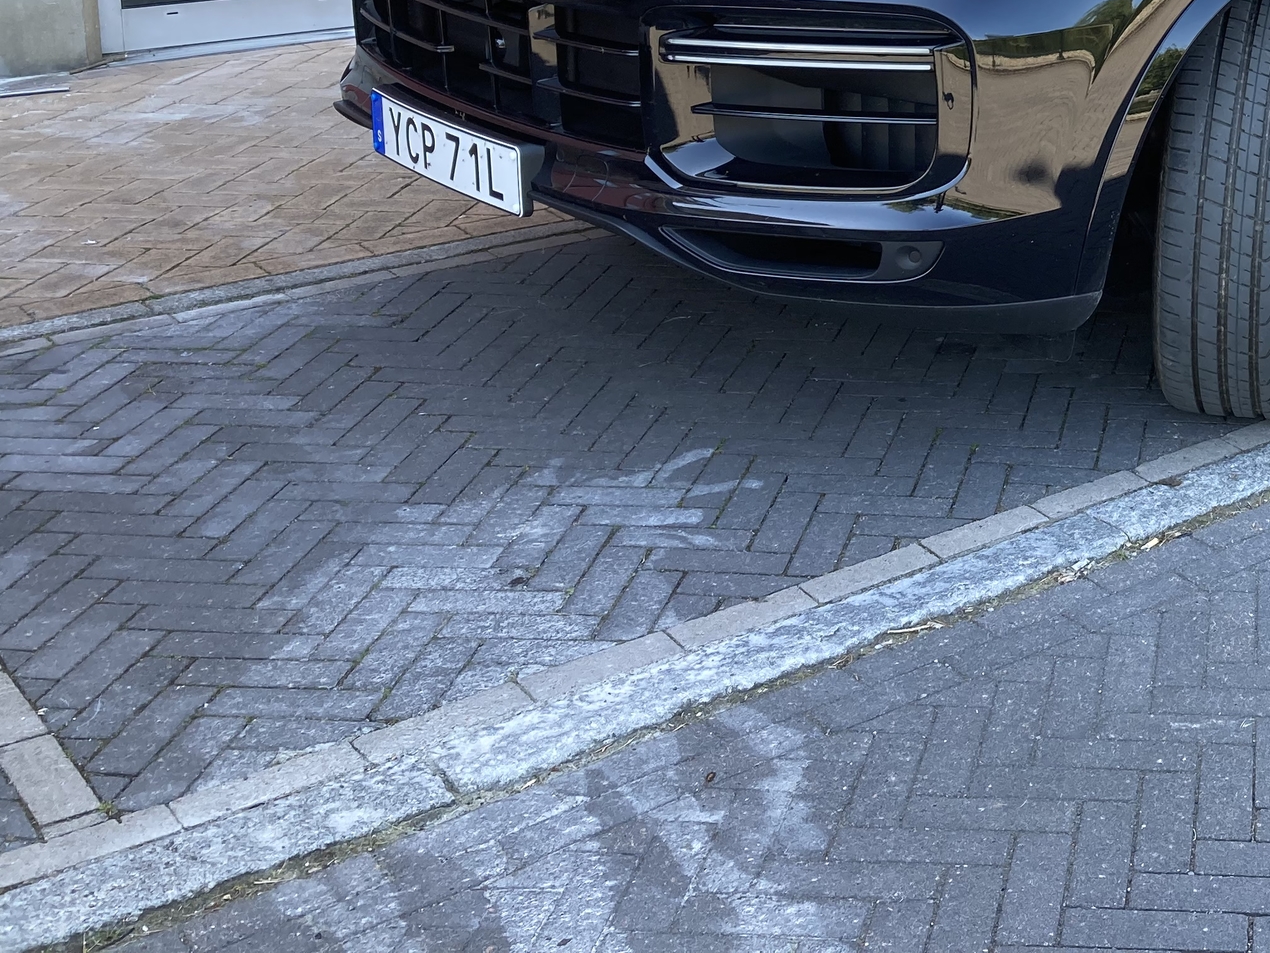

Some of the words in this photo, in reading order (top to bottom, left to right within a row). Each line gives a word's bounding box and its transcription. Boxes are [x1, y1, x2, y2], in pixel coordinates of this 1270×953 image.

[377, 129, 383, 142] S
[388, 106, 436, 170] YCP
[445, 131, 504, 202] 71L
